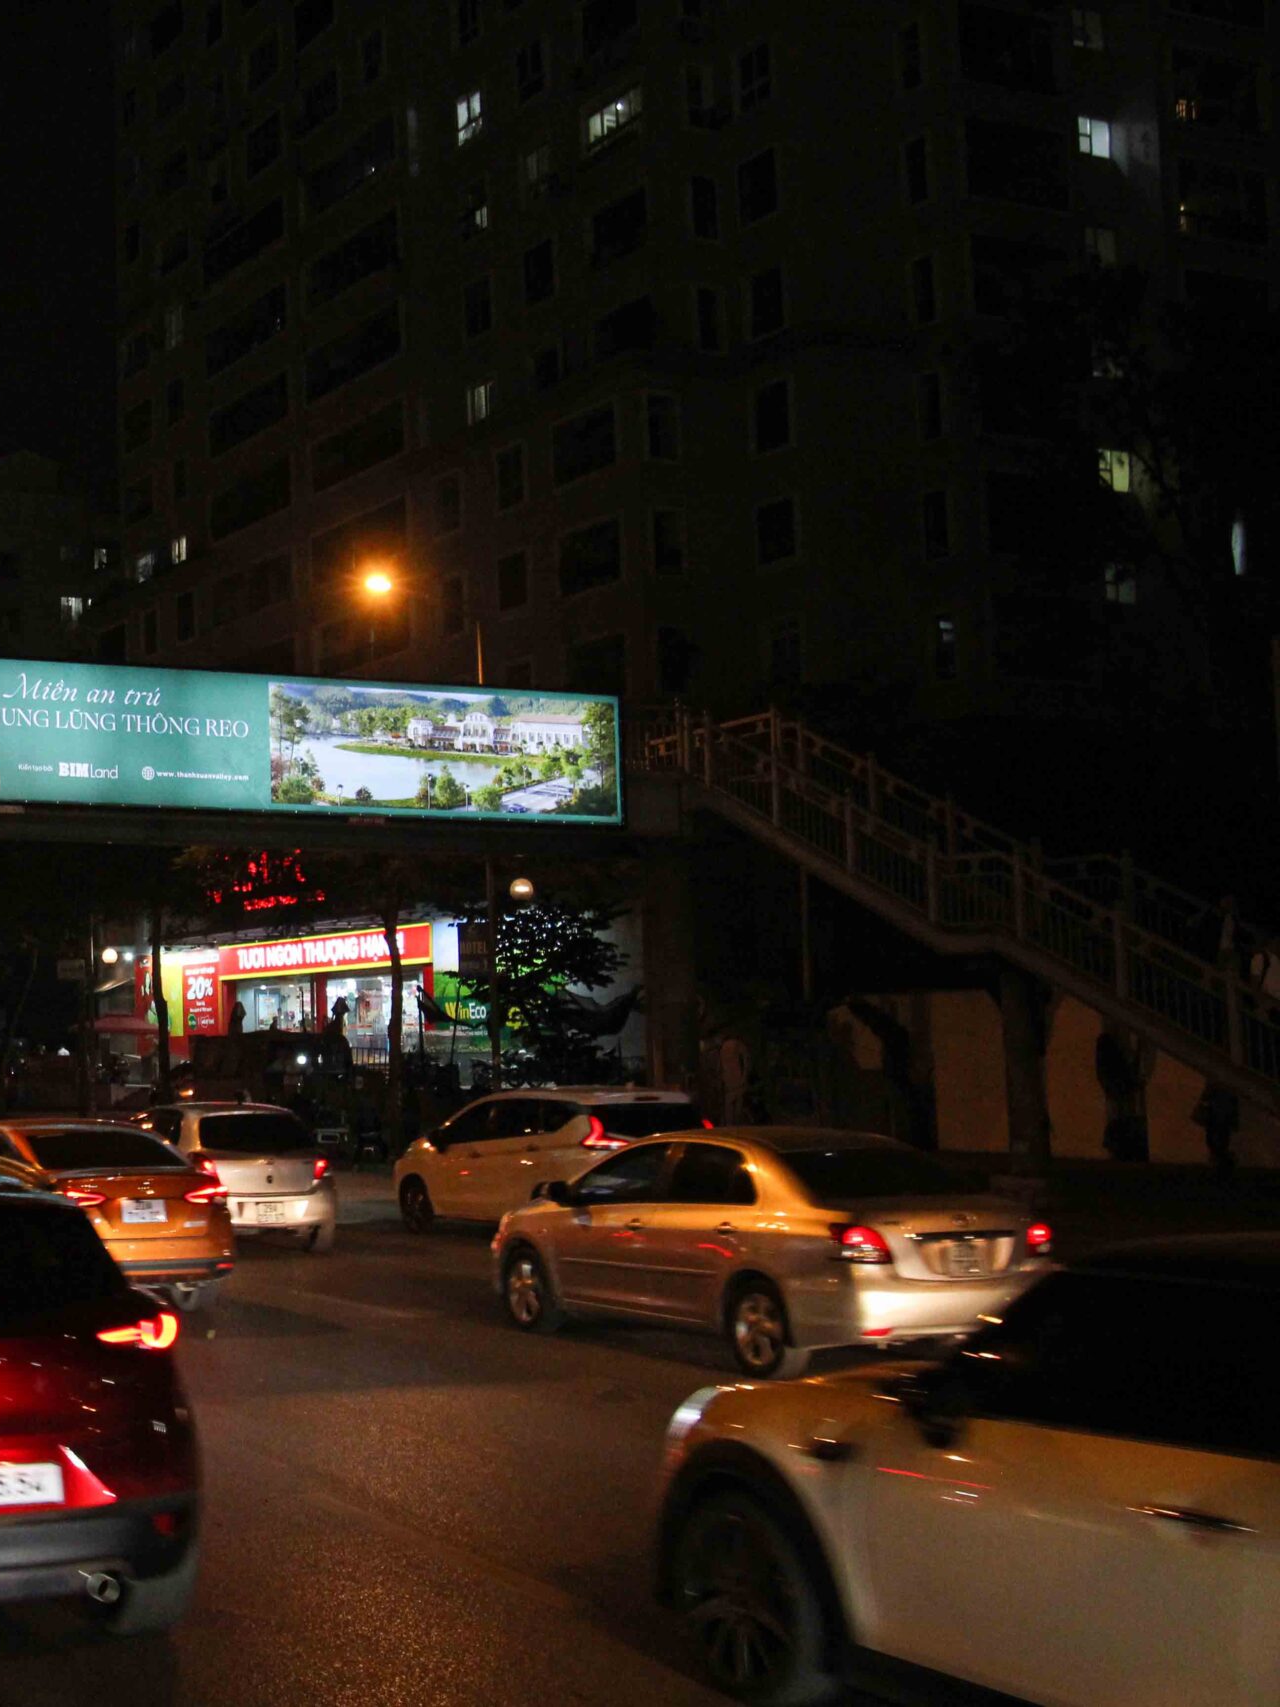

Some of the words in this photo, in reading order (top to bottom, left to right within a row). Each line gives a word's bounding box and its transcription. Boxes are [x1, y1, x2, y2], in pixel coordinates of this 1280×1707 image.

[2, 672, 78, 702] Miền
[86, 687, 116, 704] an
[123, 687, 161, 706] trú
[55, 708, 116, 732] LŨNG
[122, 711, 200, 736] THÔNG
[206, 718, 249, 738] REO
[267, 943, 303, 967] NGON
[186, 976, 214, 1001] 20%
[444, 1001, 487, 1021] WinEco
